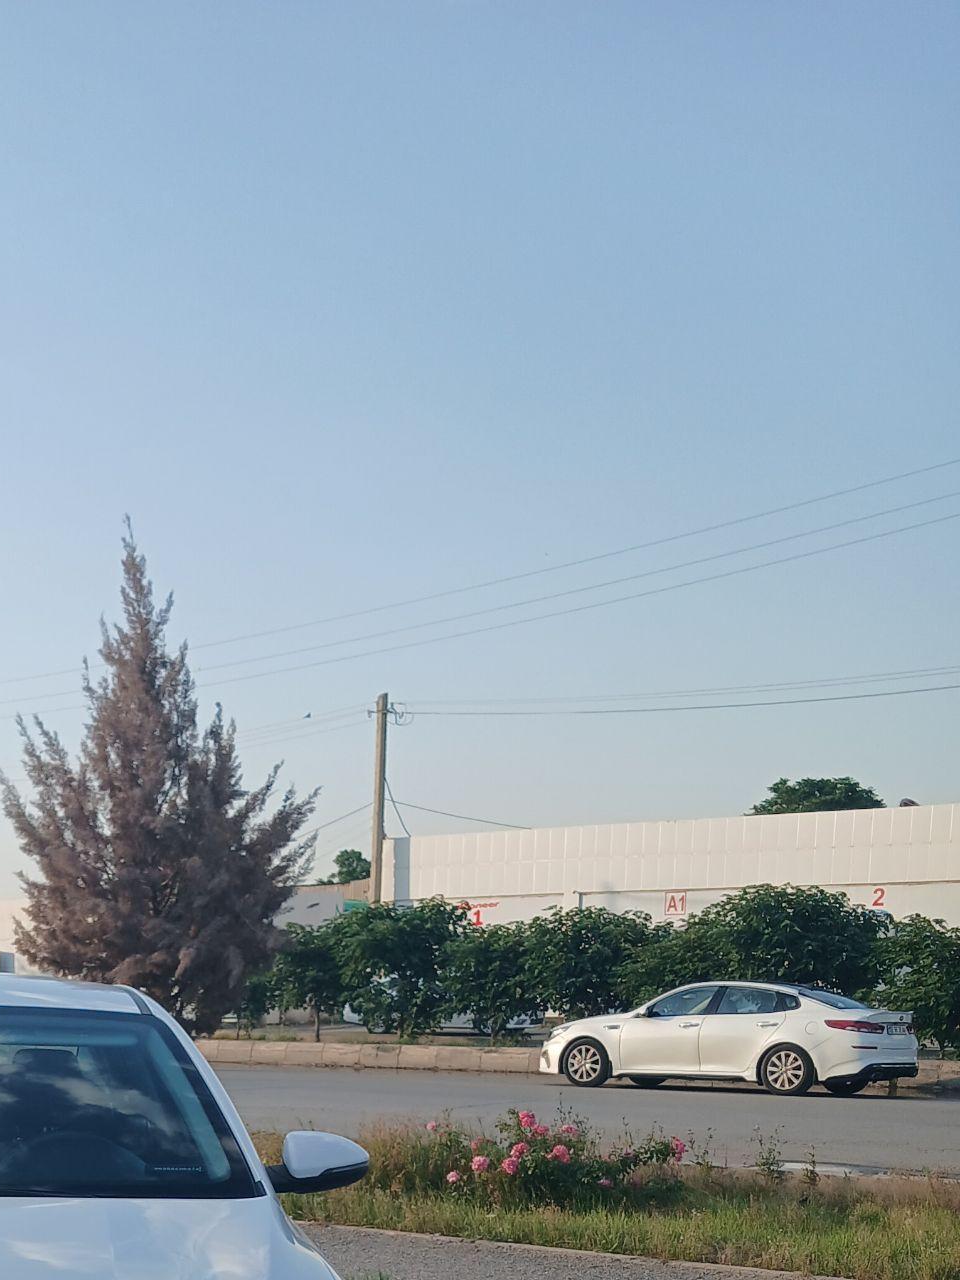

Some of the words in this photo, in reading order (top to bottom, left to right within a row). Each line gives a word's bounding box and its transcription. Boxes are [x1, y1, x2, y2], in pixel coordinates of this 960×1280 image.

[667, 894, 685, 912] A1
[872, 887, 885, 907] 2
[473, 910, 483, 926] 1
